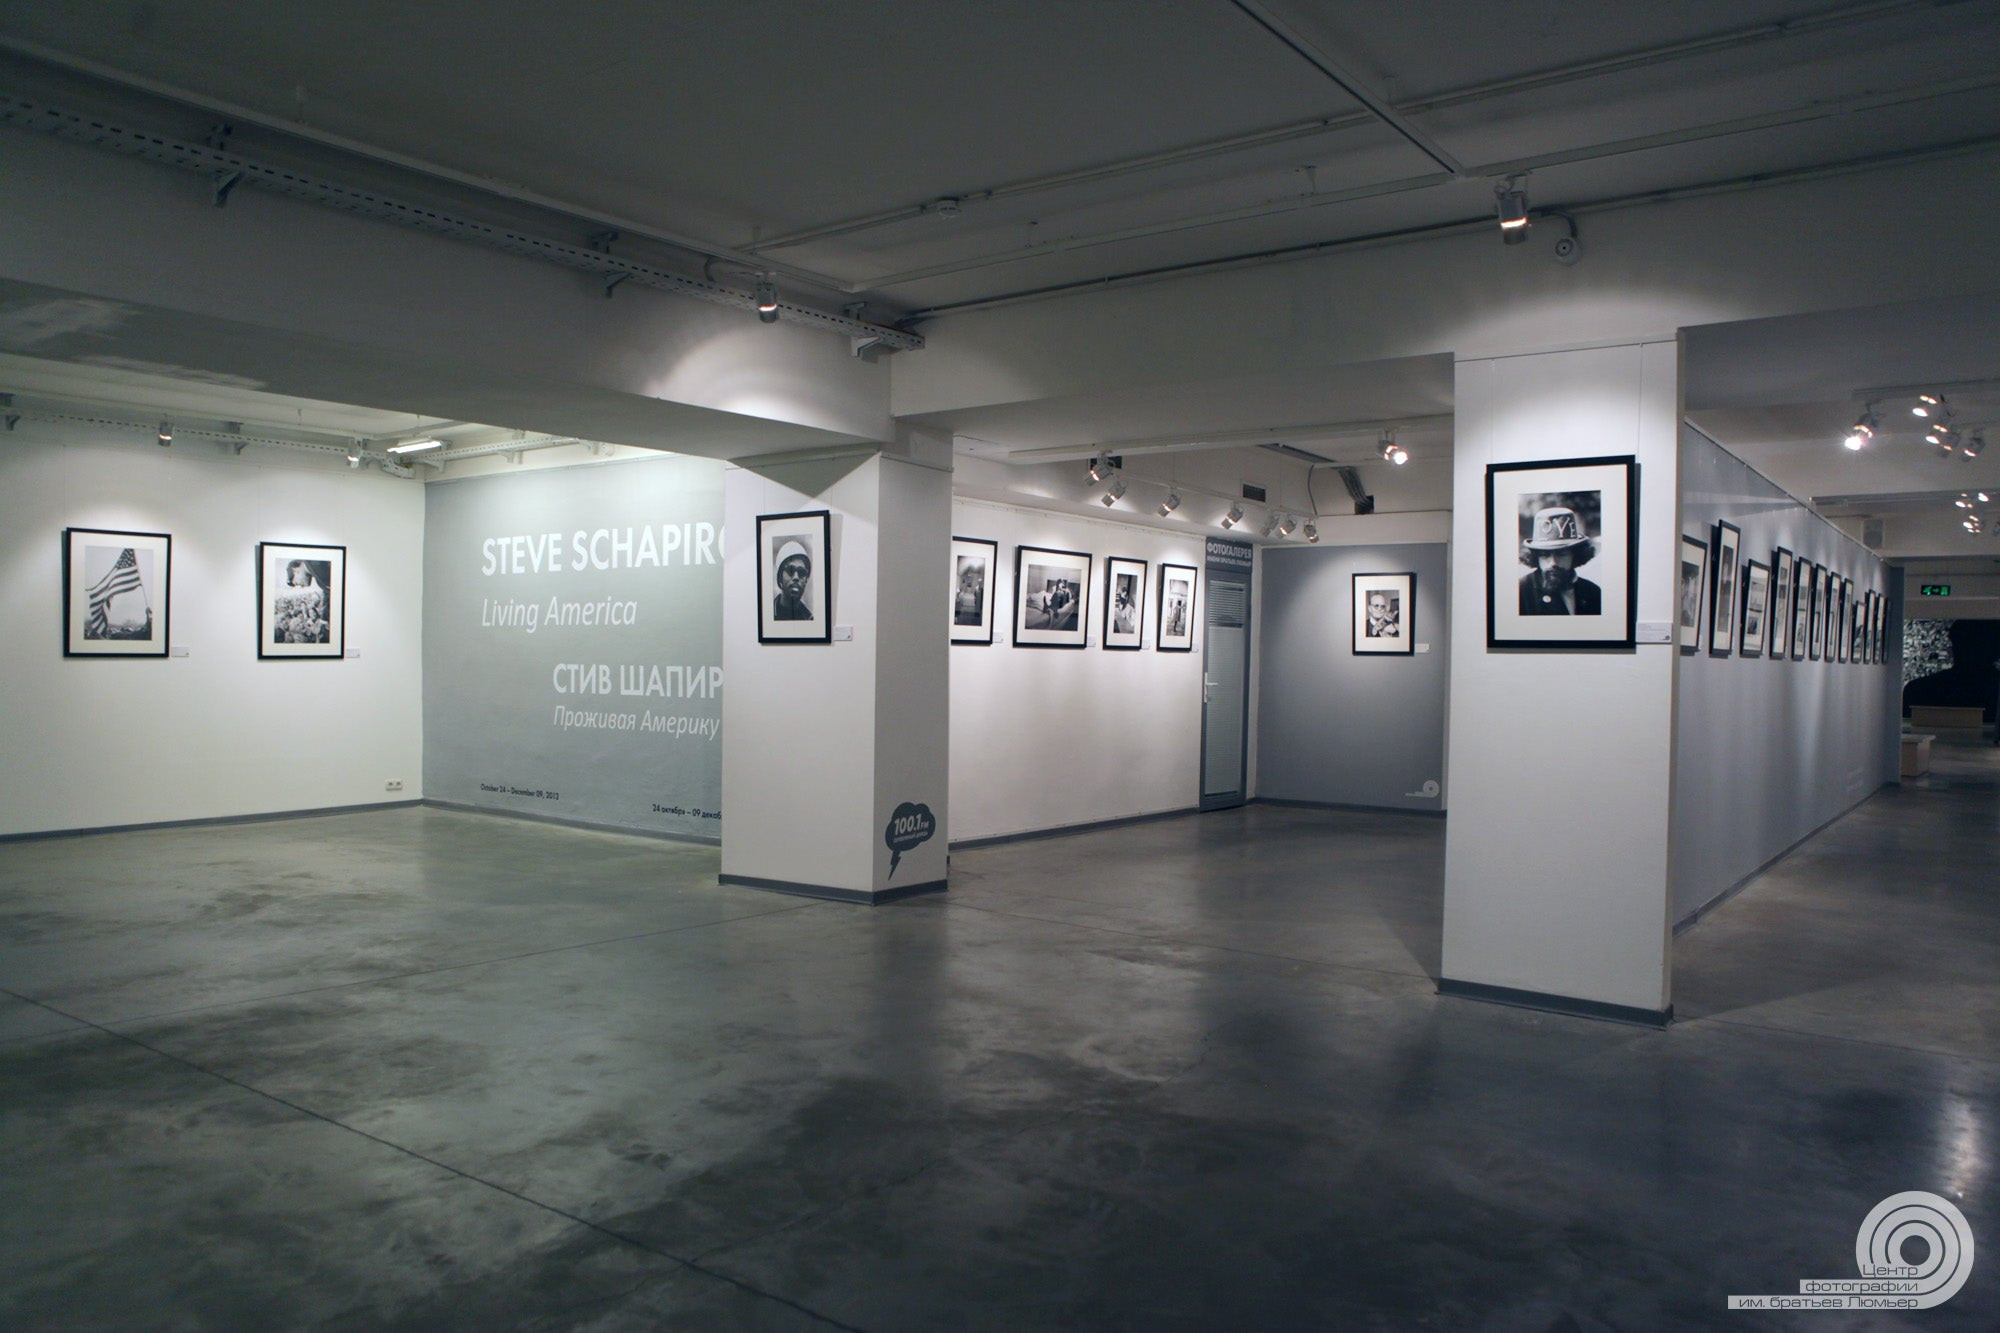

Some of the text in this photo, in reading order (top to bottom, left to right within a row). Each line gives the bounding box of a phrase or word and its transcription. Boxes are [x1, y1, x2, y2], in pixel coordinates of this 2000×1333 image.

[482, 533, 562, 576] STEVE
[1207, 542, 1252, 559] ФОТОГАЛЕРЕЯ
[482, 596, 637, 633] Living America
[553, 663, 724, 698] СТИВ ШАПИР
[553, 705, 720, 741] Проживая Америку
[500, 785, 506, 793] 24
[546, 791, 560, 800] 2012
[652, 803, 660, 812] 24
[661, 806, 685, 817] октября
[692, 808, 700, 817] 09
[894, 813, 922, 836] 100.1
